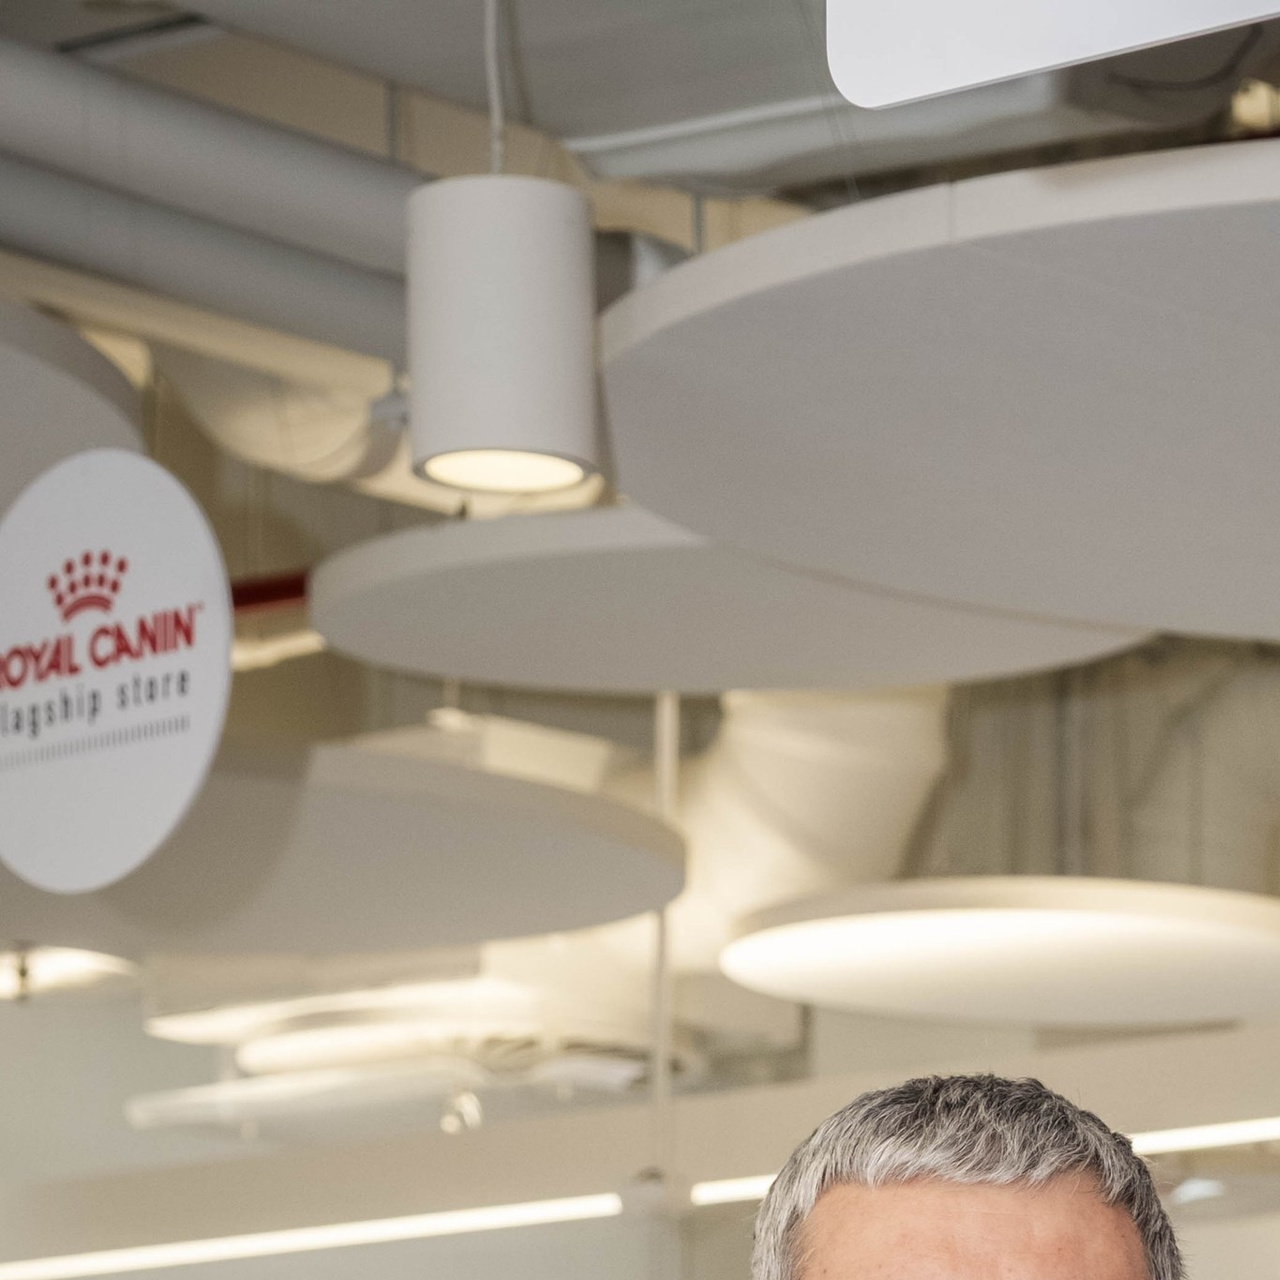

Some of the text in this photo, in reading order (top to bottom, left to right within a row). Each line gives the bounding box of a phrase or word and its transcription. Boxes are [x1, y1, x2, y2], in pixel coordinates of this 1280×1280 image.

[90, 607, 196, 668] CANIN
[0, 670, 190, 740] lagship store
